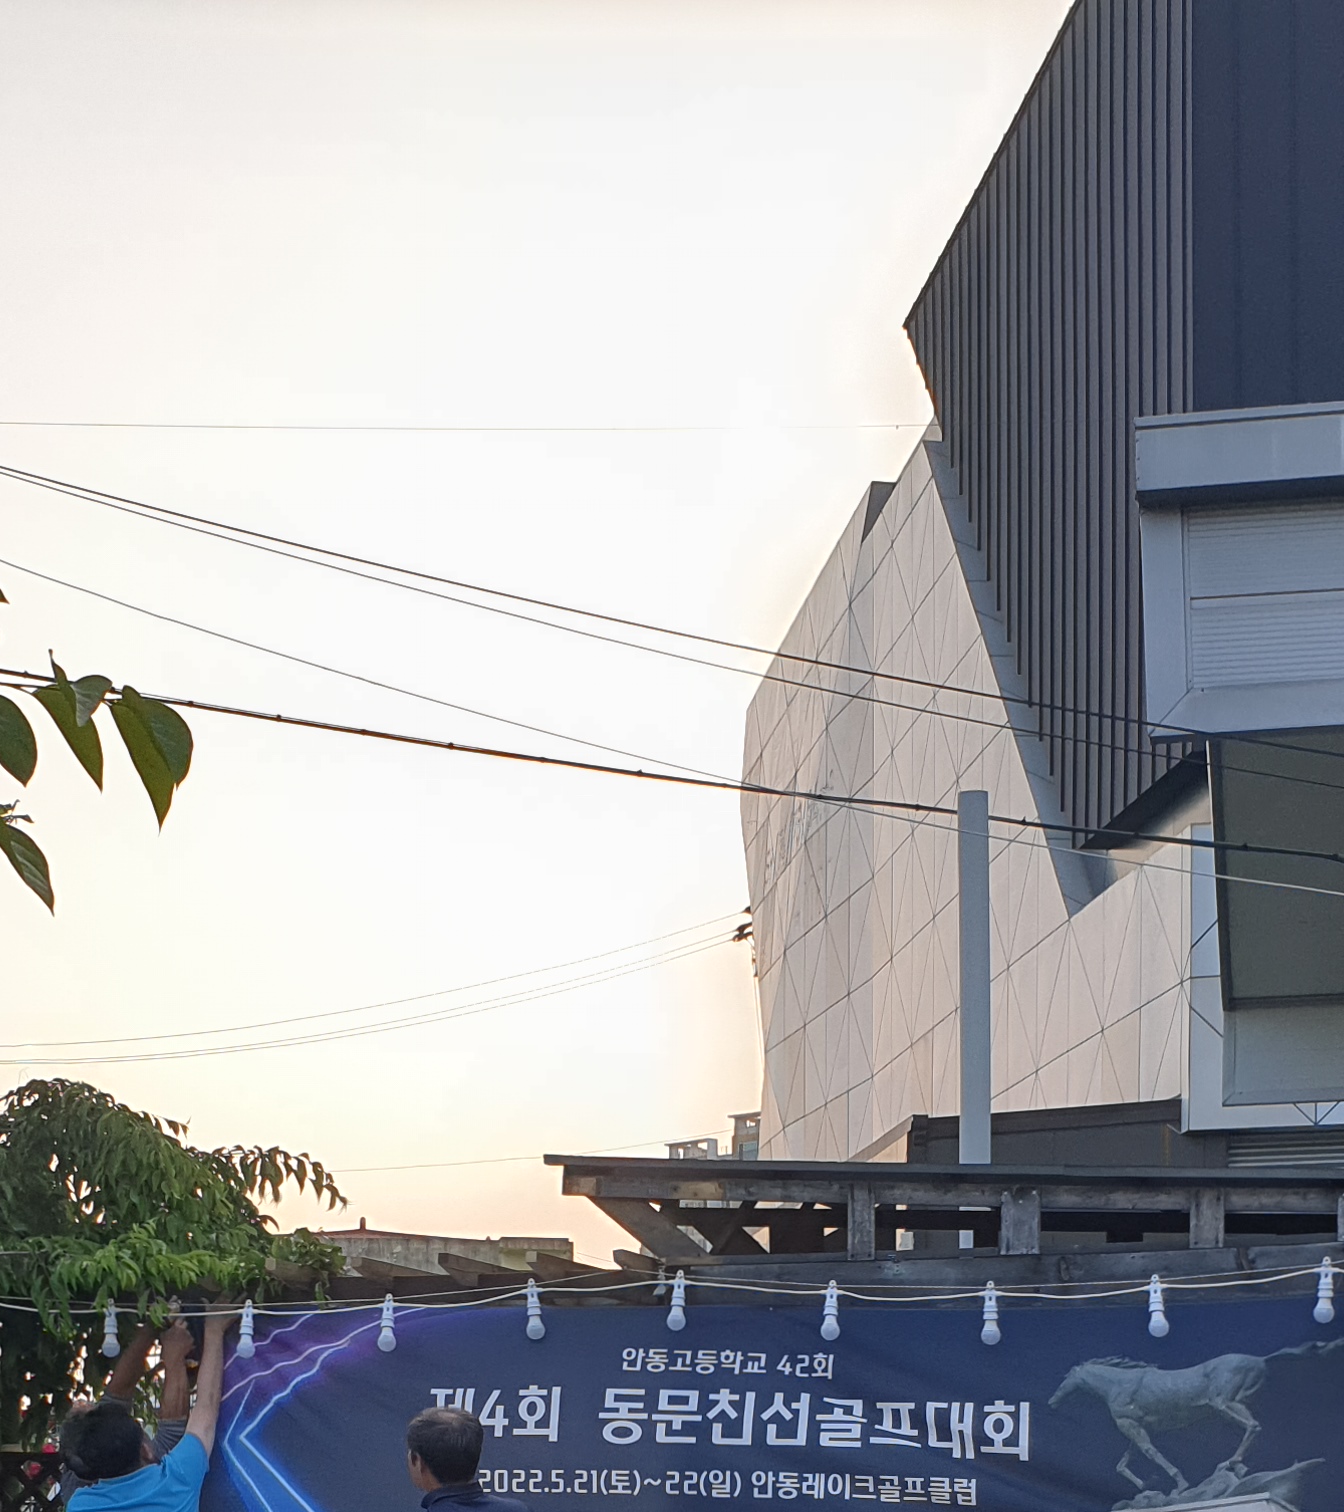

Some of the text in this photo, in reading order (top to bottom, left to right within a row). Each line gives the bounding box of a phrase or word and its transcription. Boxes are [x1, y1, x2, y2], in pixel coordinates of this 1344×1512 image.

[621, 1347, 835, 1379] 안동고등학교 42회
[598, 1387, 1030, 1461] 동문친선골프대회
[751, 1470, 977, 1506] 안동레이크골프클럽
